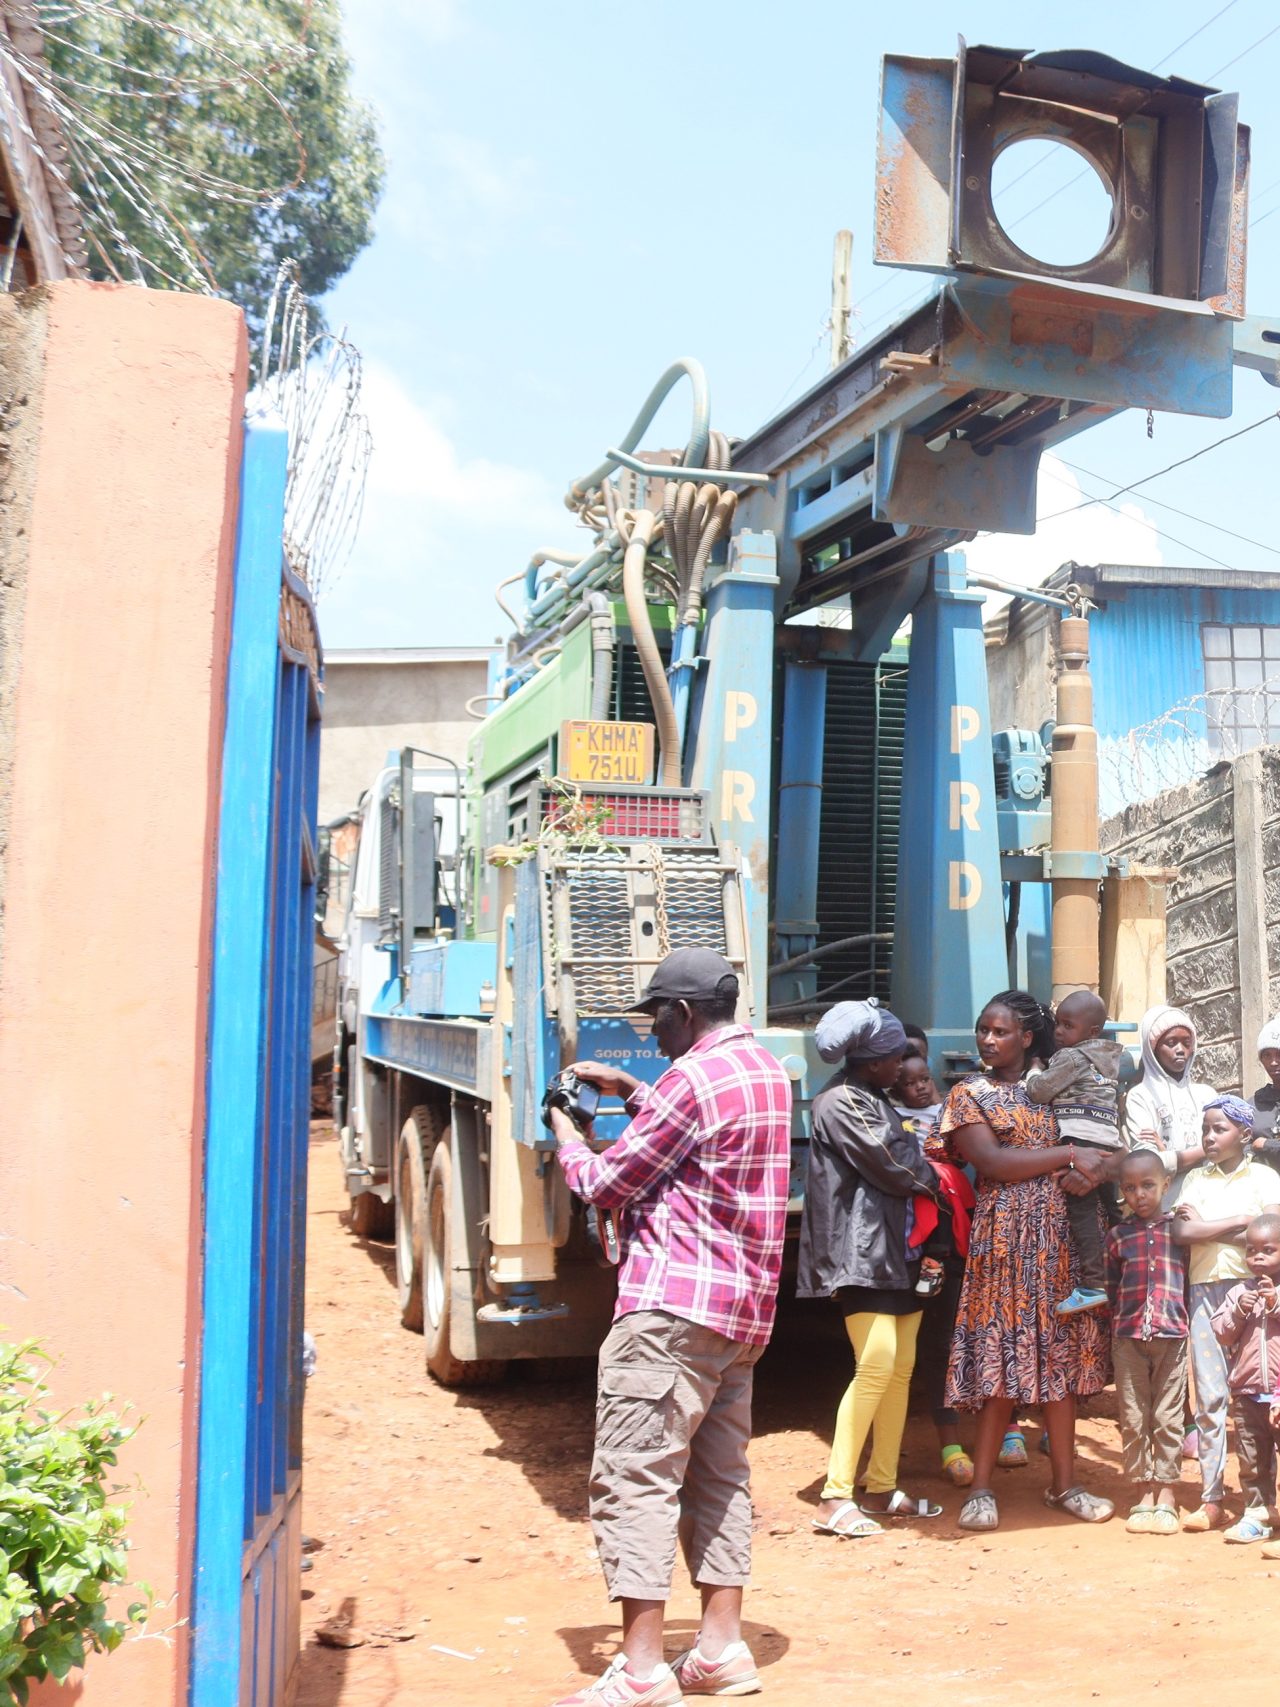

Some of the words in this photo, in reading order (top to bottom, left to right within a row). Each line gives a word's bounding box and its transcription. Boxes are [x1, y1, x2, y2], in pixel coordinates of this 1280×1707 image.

[588, 725, 638, 752] KHMA
[588, 754, 637, 781] 751U
[594, 1049, 632, 1059] GOOD
[634, 1049, 652, 1059] TO
